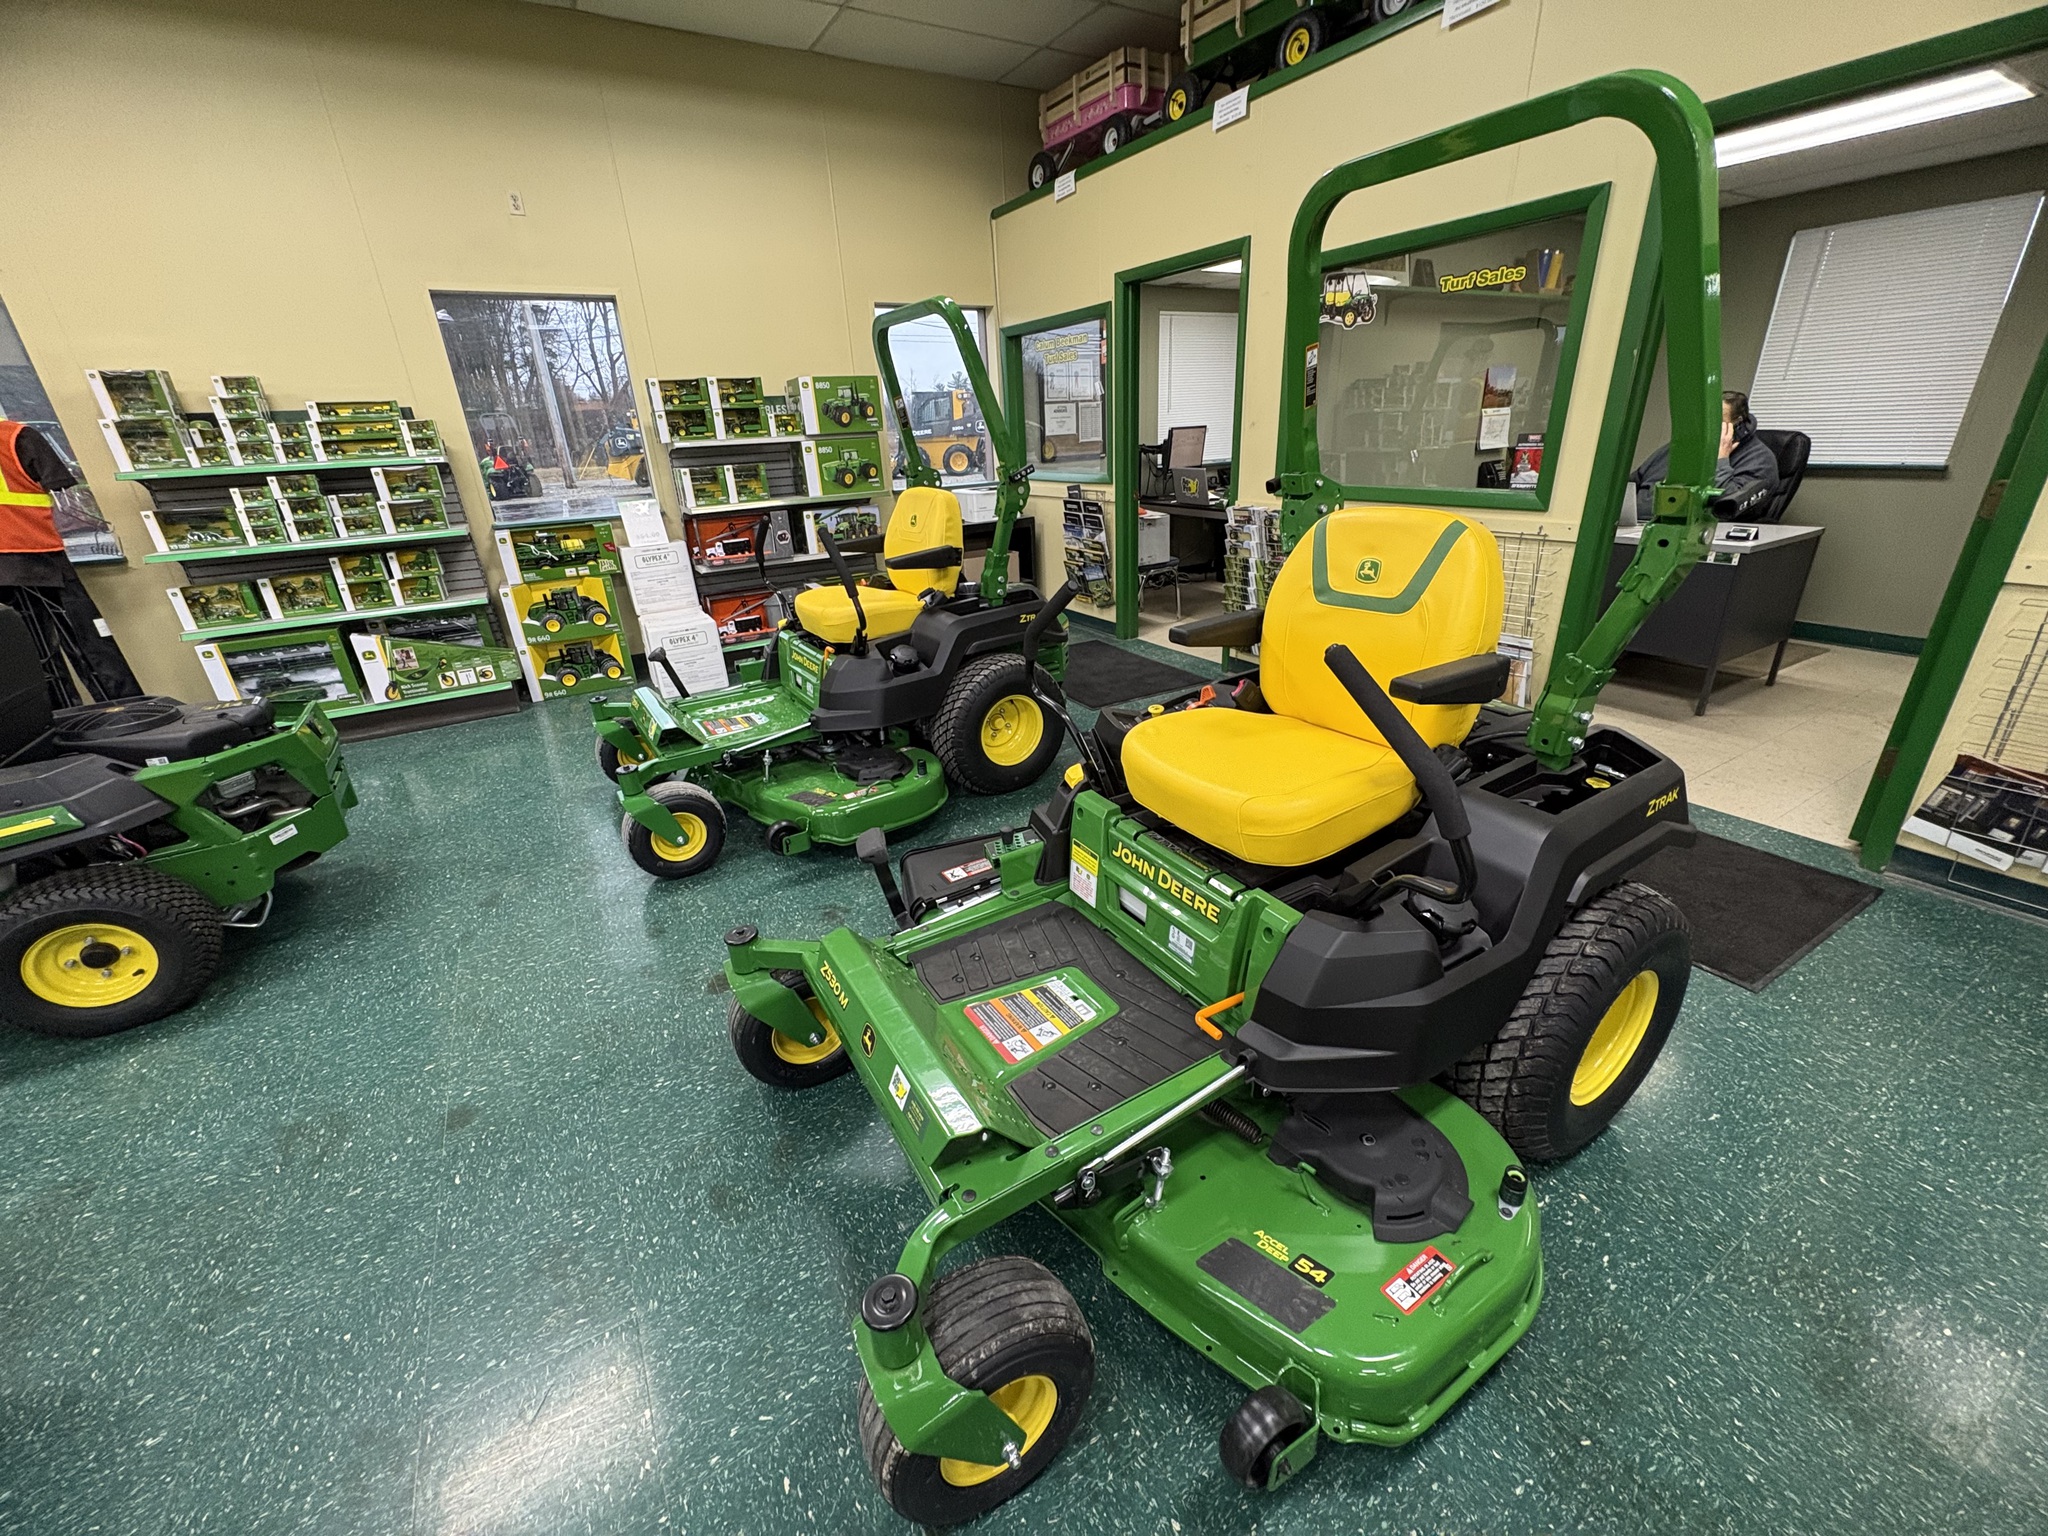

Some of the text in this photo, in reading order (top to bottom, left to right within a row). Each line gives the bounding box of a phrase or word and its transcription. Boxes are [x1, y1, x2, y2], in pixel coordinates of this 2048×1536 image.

[1440, 265, 1526, 293] Turf Sales
[1058, 351, 1078, 363] Sales
[765, 404, 787, 414] BLES
[1019, 613, 1036, 623] ZTR
[537, 634, 551, 642] 640
[553, 689, 567, 697] 640
[1645, 787, 1680, 817] ZTRAK
[1112, 840, 1154, 881] JOHN
[1157, 867, 1221, 924] DEERE
[820, 960, 841, 996] Z530
[1253, 1229, 1290, 1256] ACCEL
[1256, 1240, 1290, 1262] DEEP
[1293, 1256, 1329, 1284] 54
[1410, 1254, 1427, 1272] DANGER
